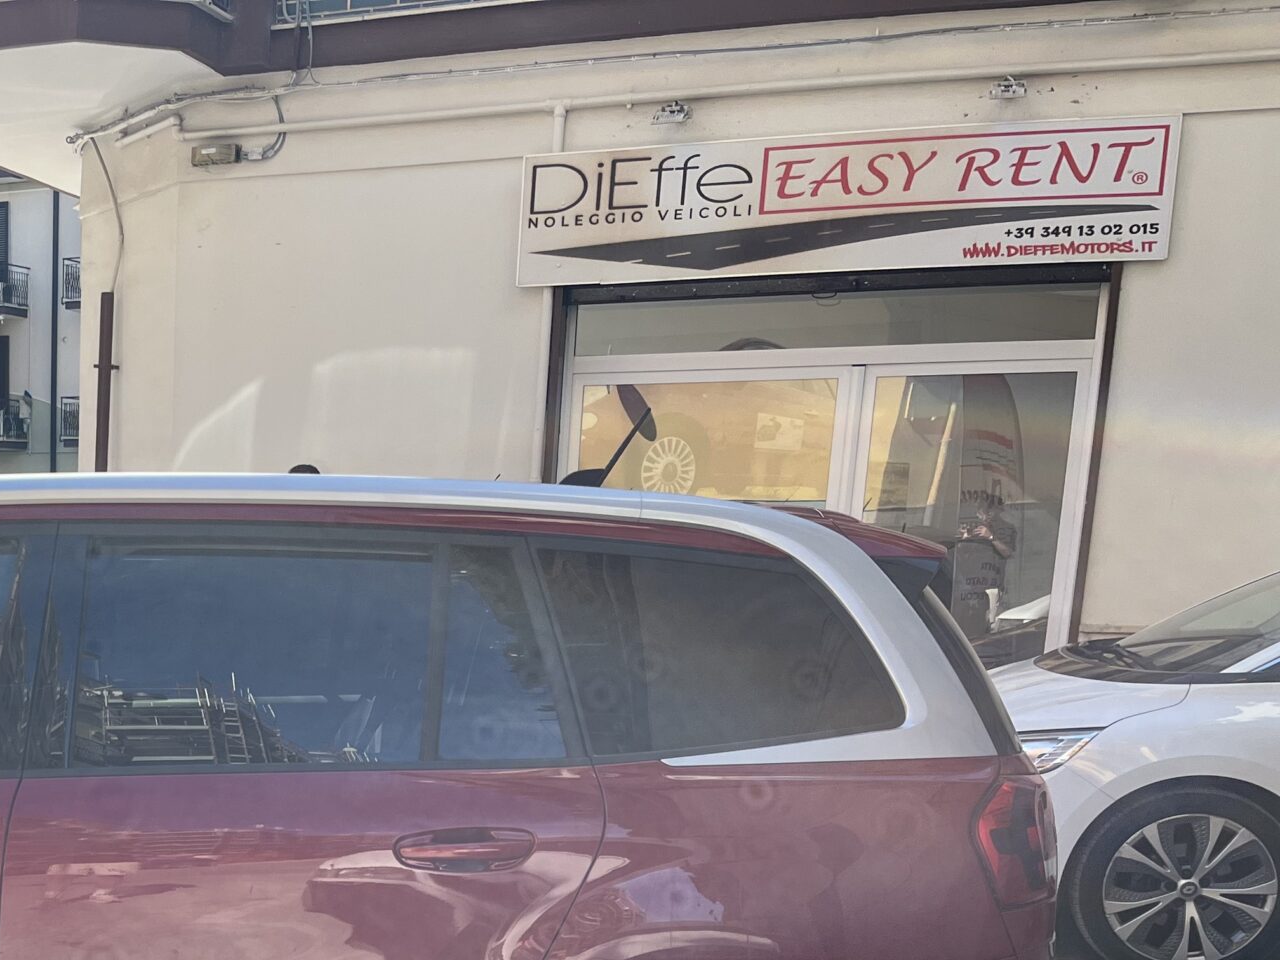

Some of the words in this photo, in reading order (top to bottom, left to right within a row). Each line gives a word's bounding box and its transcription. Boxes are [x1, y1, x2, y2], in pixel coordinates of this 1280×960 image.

[529, 153, 753, 215] DiEffe
[775, 151, 938, 199] EASY
[527, 211, 644, 229] NOLEGGIO
[658, 204, 752, 221] VEICOLI
[1004, 226, 1035, 239] +39
[1040, 225, 1072, 238] 349
[1077, 224, 1095, 237] 13
[1100, 223, 1123, 236] 02
[1129, 222, 1160, 235] 015
